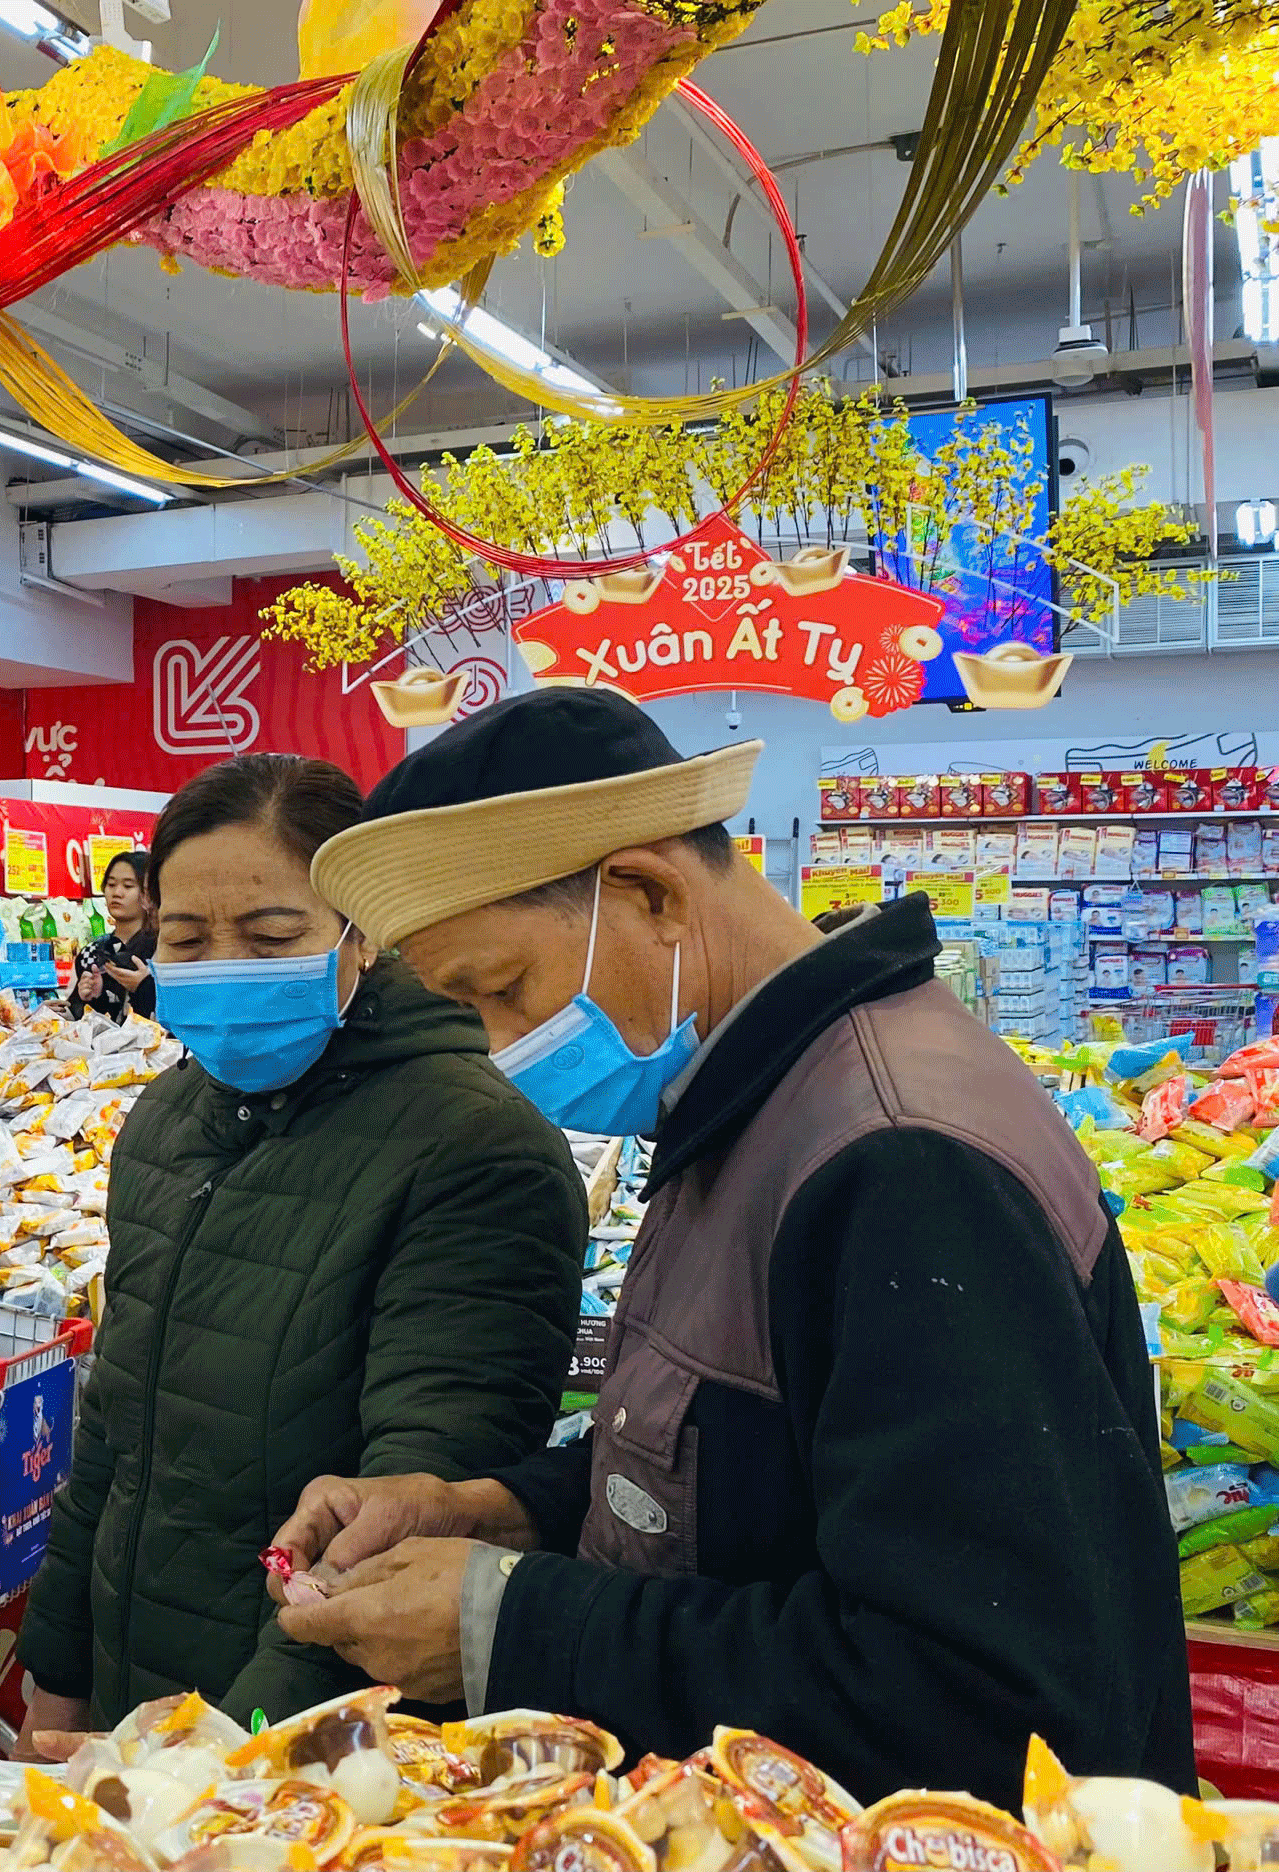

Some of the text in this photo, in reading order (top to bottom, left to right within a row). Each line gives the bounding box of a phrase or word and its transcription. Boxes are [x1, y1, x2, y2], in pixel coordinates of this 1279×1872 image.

[684, 538, 743, 571] Tết
[682, 574, 752, 602] 2025
[576, 597, 864, 686] Xuân Ất Tỵ
[1134, 757, 1198, 770] WELCOME
[22, 1441, 53, 1483] Tiger
